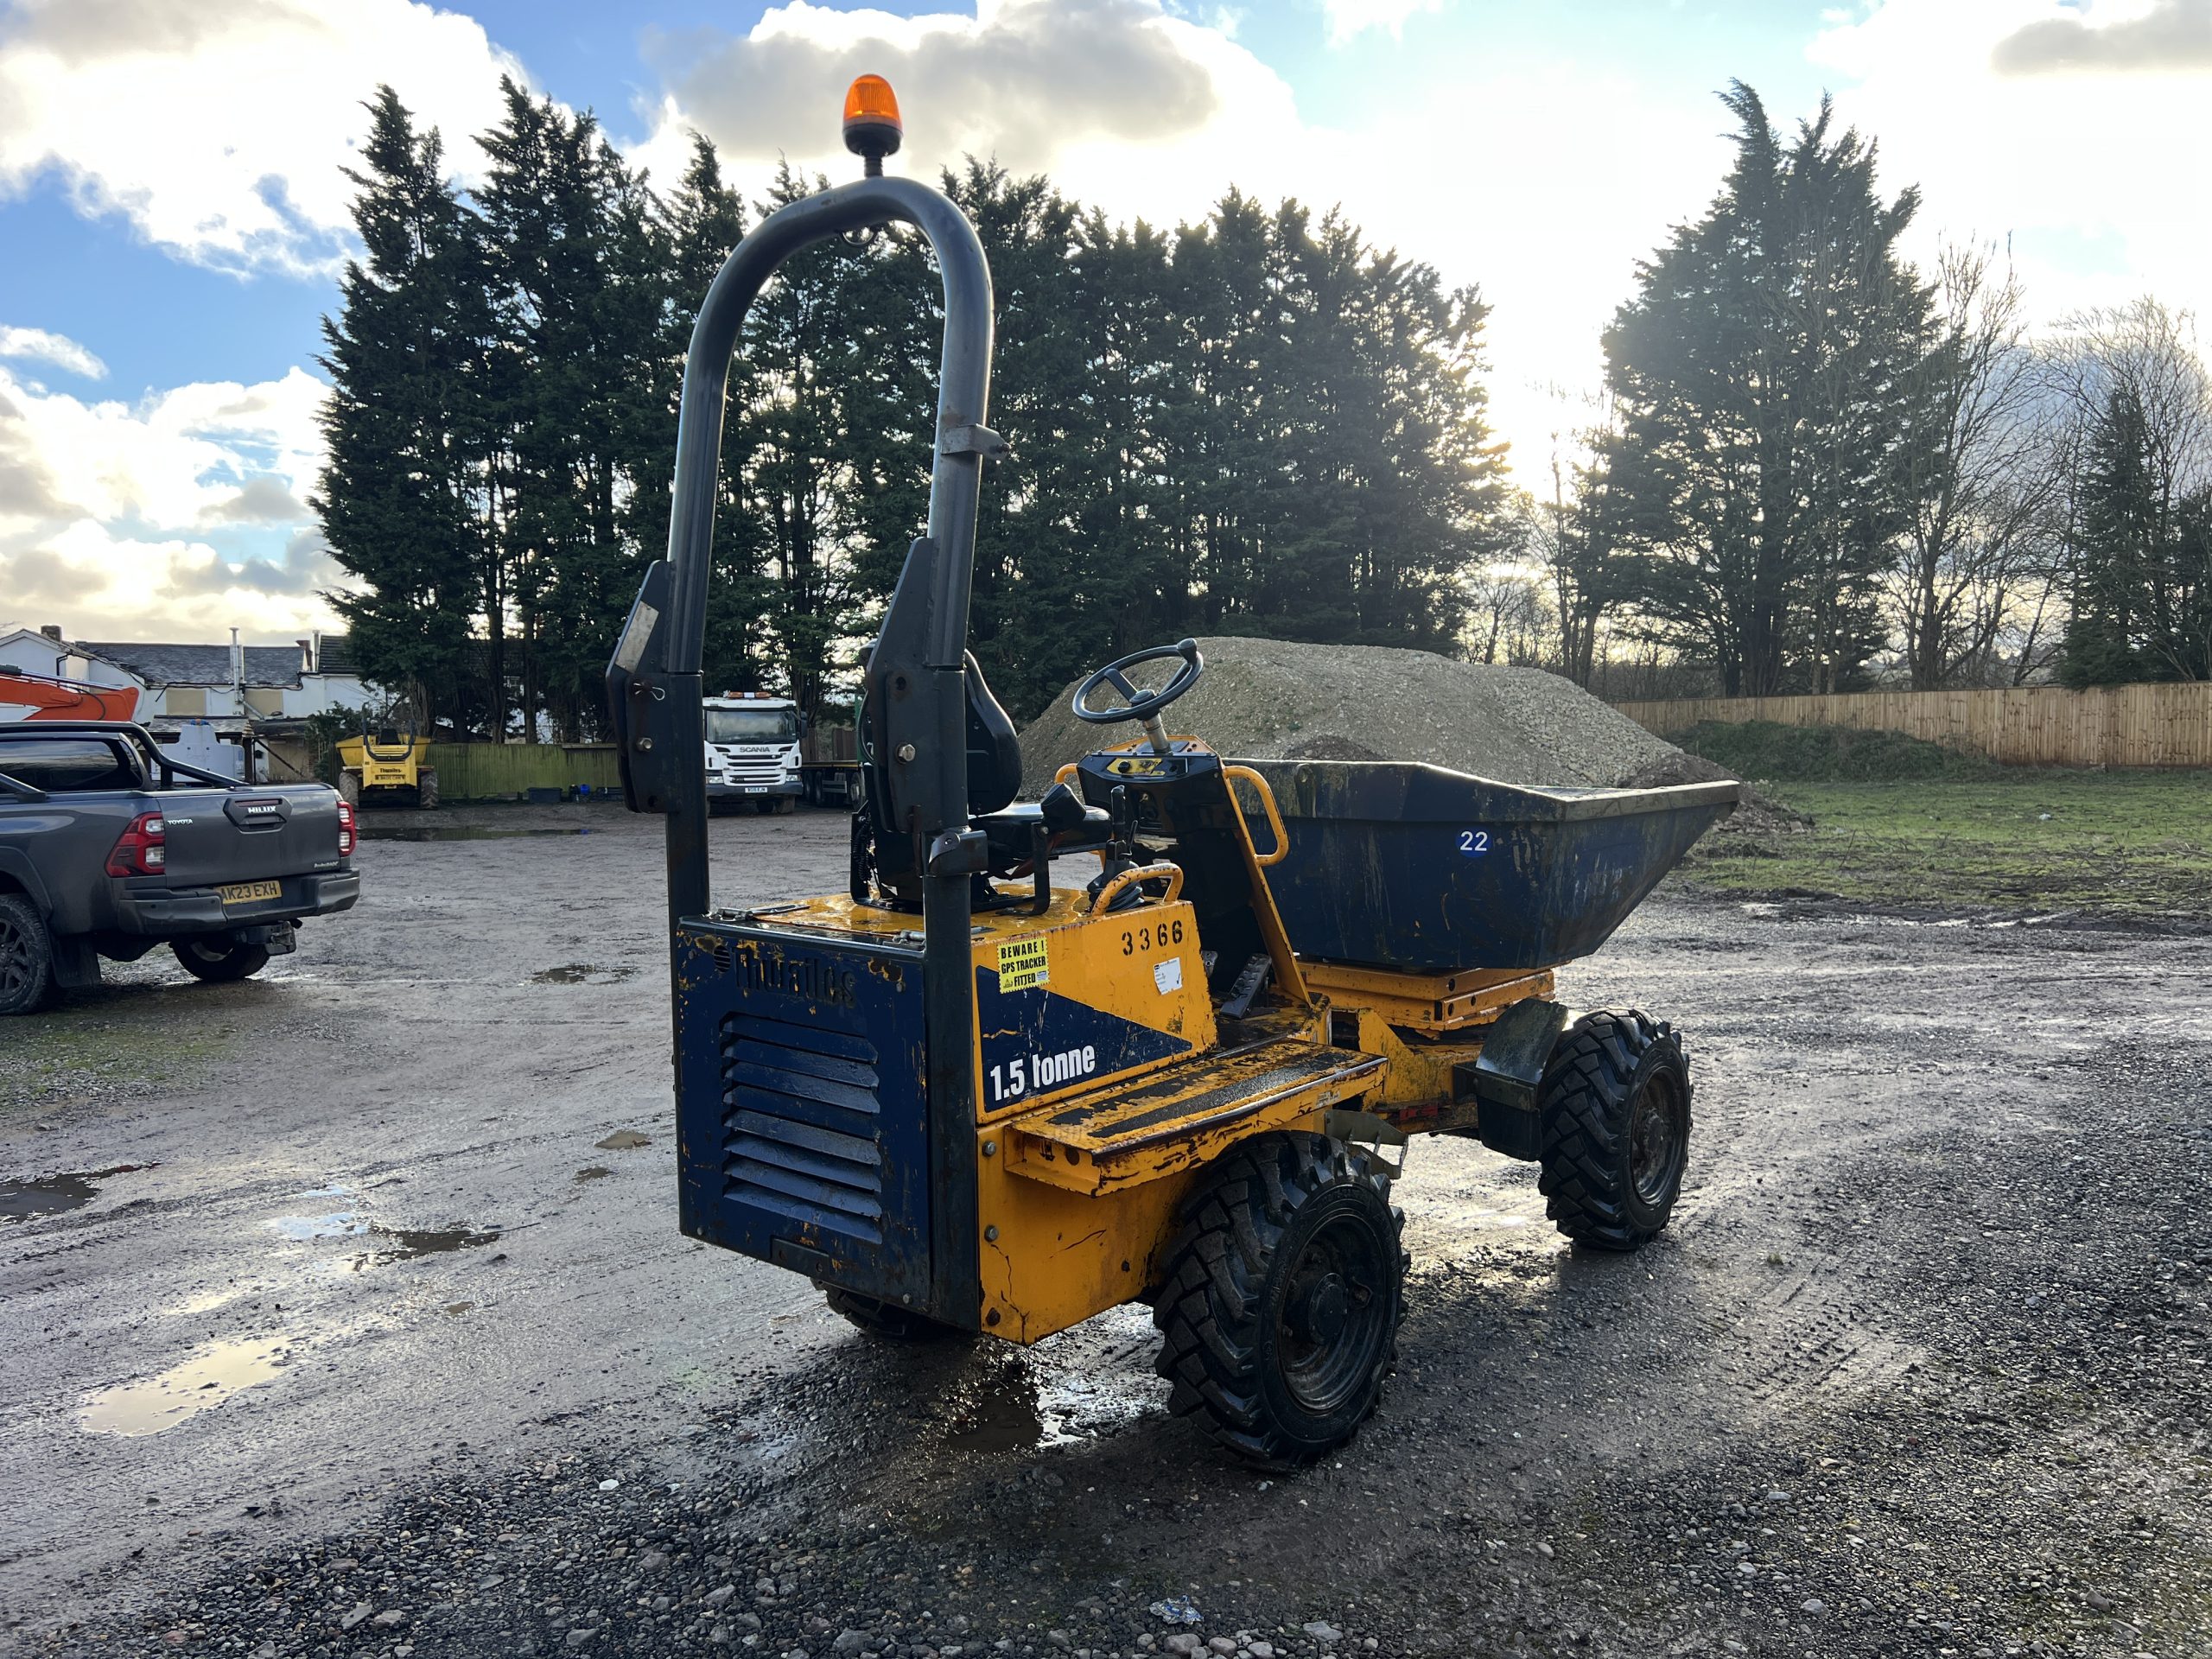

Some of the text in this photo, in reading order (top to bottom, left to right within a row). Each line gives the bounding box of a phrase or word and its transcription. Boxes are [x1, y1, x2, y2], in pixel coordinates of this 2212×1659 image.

[1459, 830, 1488, 851] 22
[254, 881, 277, 898] EXH
[1122, 920, 1183, 956] 3366
[1001, 941, 1038, 959] BEWARE
[1001, 956, 1046, 975] GPS TRACKER
[1014, 972, 1036, 987] FITTED
[990, 1045, 1096, 1102] 1.5 tonne
